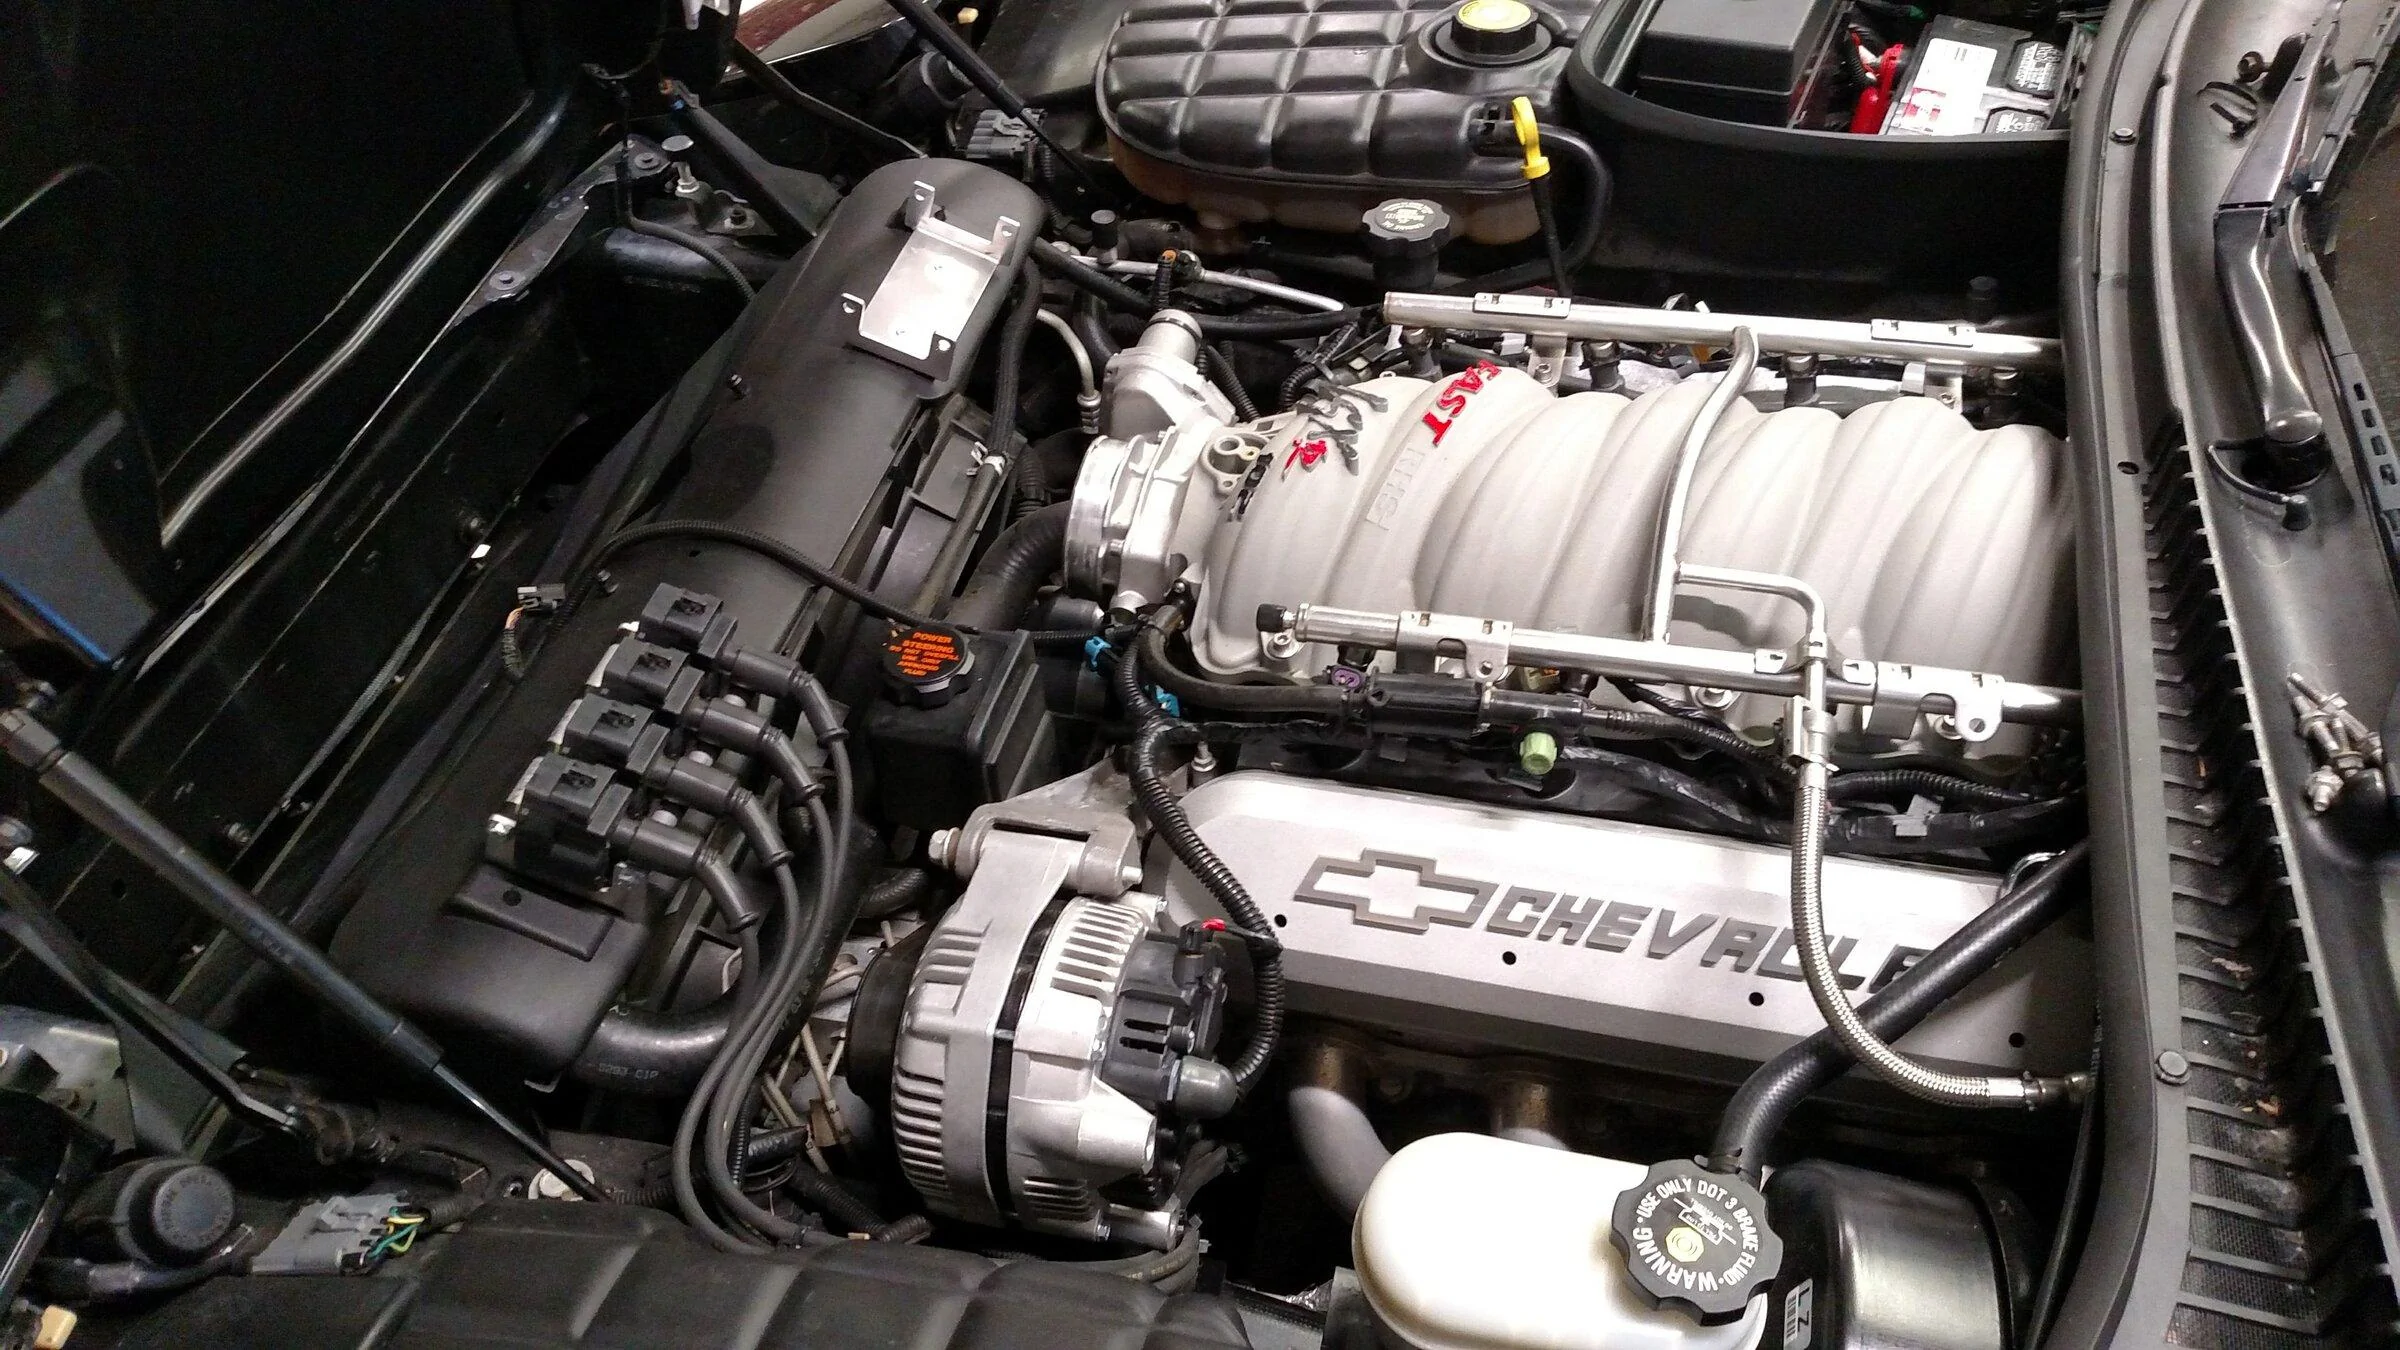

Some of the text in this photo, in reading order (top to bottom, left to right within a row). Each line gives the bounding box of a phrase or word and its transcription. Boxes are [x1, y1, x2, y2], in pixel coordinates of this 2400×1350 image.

[1422, 359, 1501, 447] FAST
[902, 640, 955, 654] STEERING
[912, 632, 953, 644] POWER
[1486, 885, 1937, 994] CHEVROLE
[1655, 1178, 1692, 1199] ONLY
[1697, 1180, 1728, 1202] DOT
[1636, 1191, 1661, 1218] USE
[1724, 1197, 1738, 1209] 3
[1732, 1207, 1759, 1252] BRAKE
[1632, 1227, 1718, 1292] WARNING
[1722, 1251, 1756, 1286] FLUID
